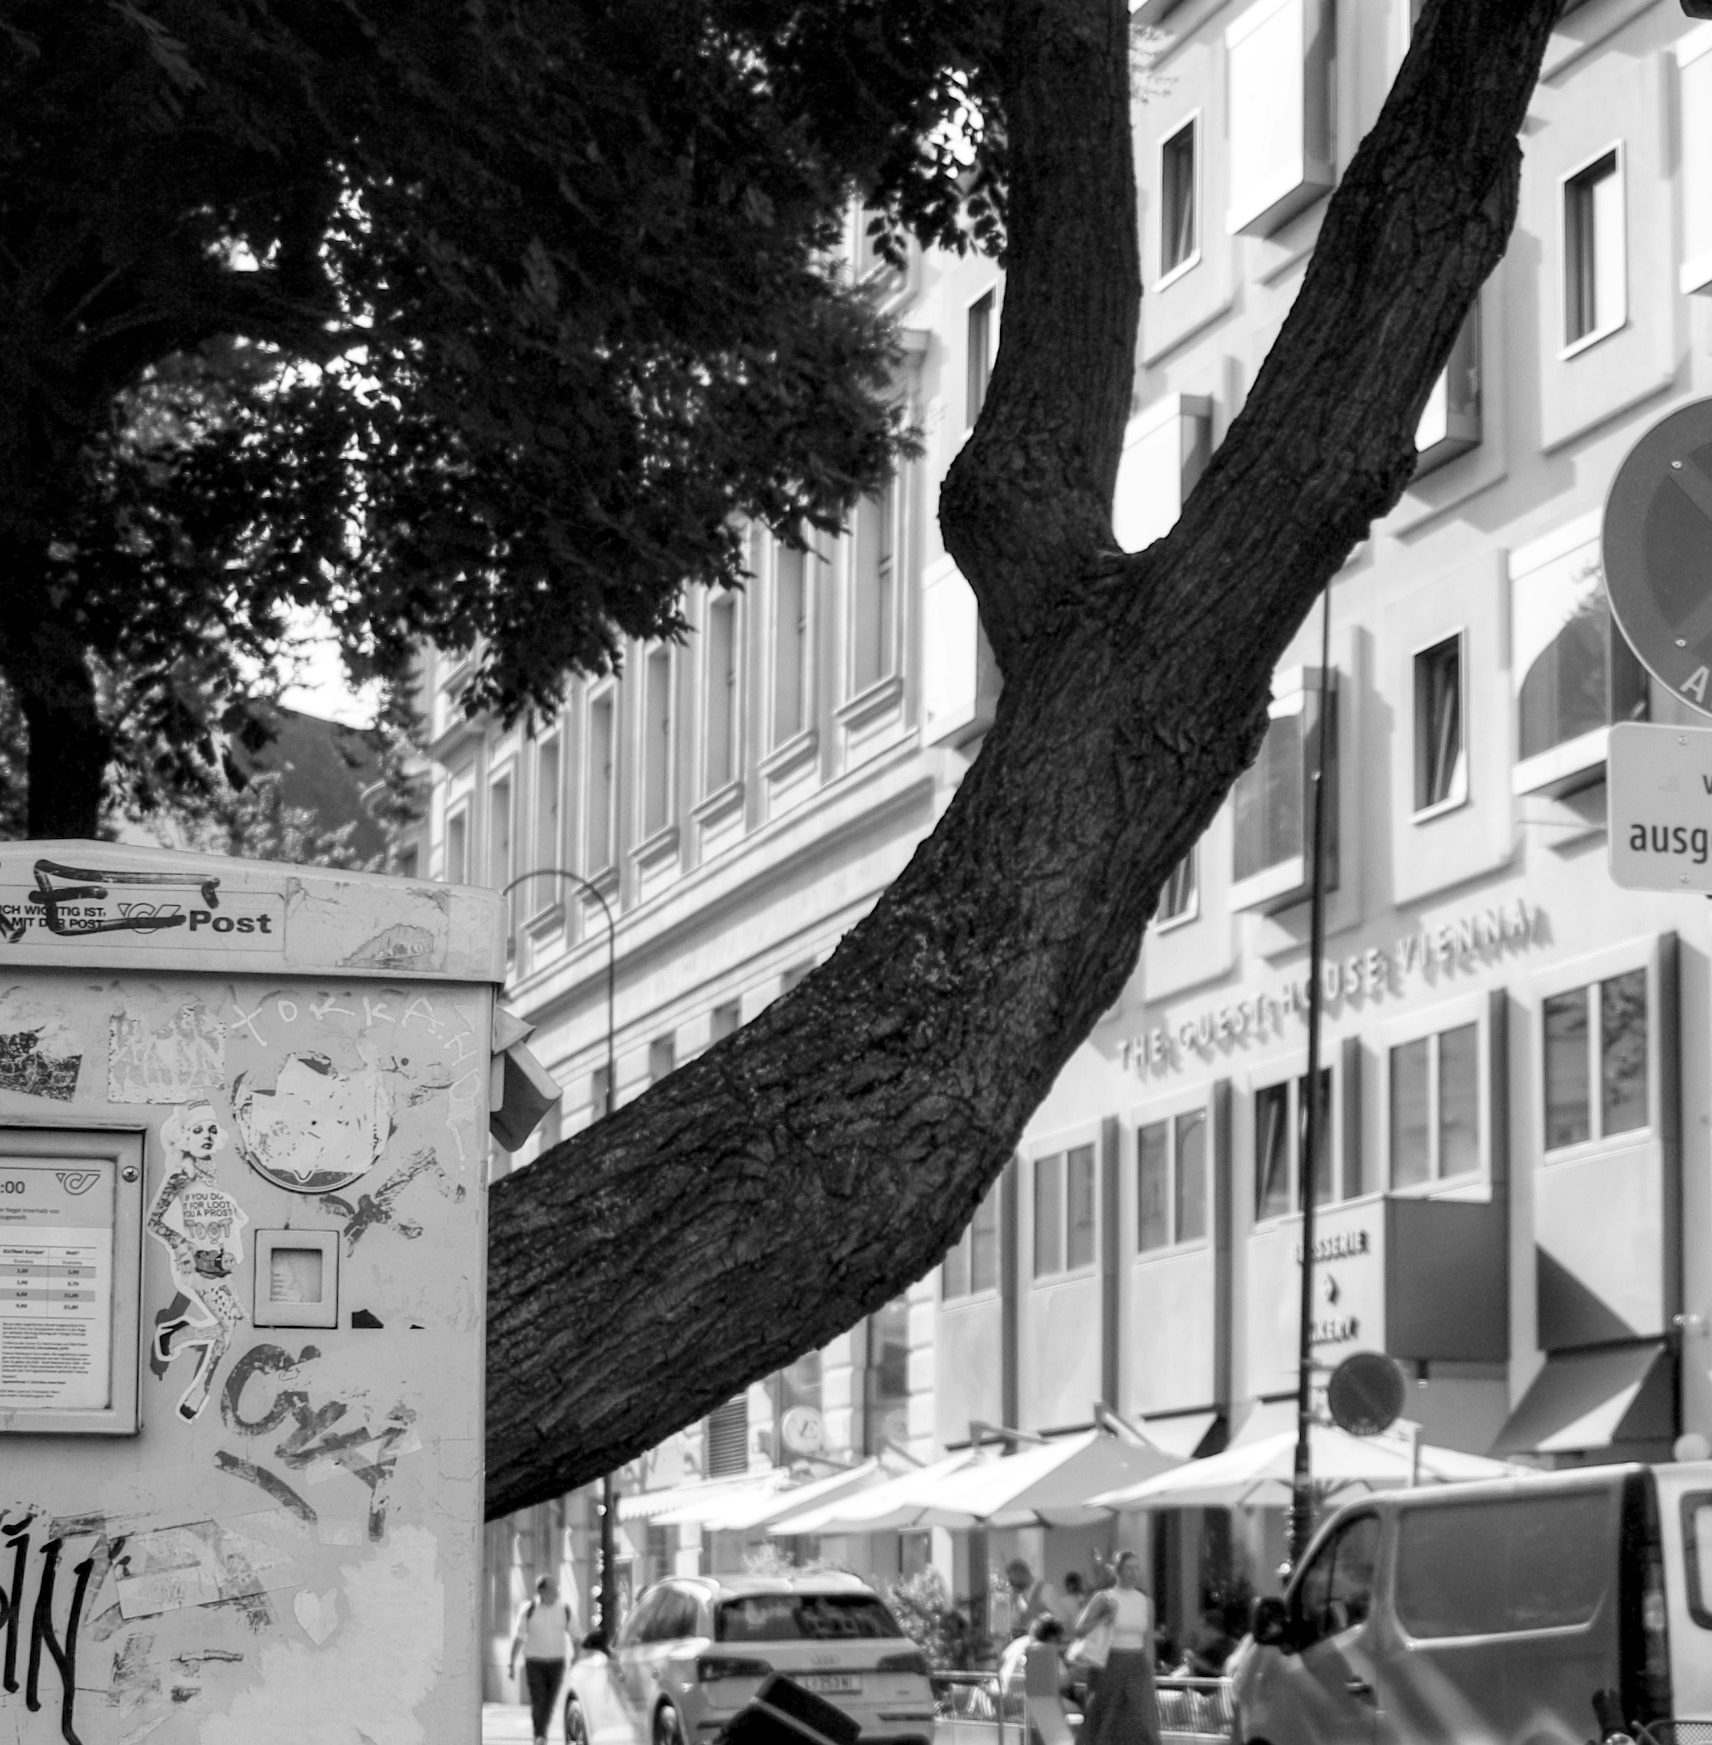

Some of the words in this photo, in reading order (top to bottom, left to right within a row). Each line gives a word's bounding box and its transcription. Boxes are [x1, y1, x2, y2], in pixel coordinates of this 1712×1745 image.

[24, 905, 80, 917] WICTIG
[189, 910, 272, 934] Post
[1117, 1028, 1164, 1073] THE
[1178, 992, 1268, 1053] GUEST
[1399, 897, 1536, 977] VIENNA
[1289, 1230, 1363, 1263] BSSERIE
